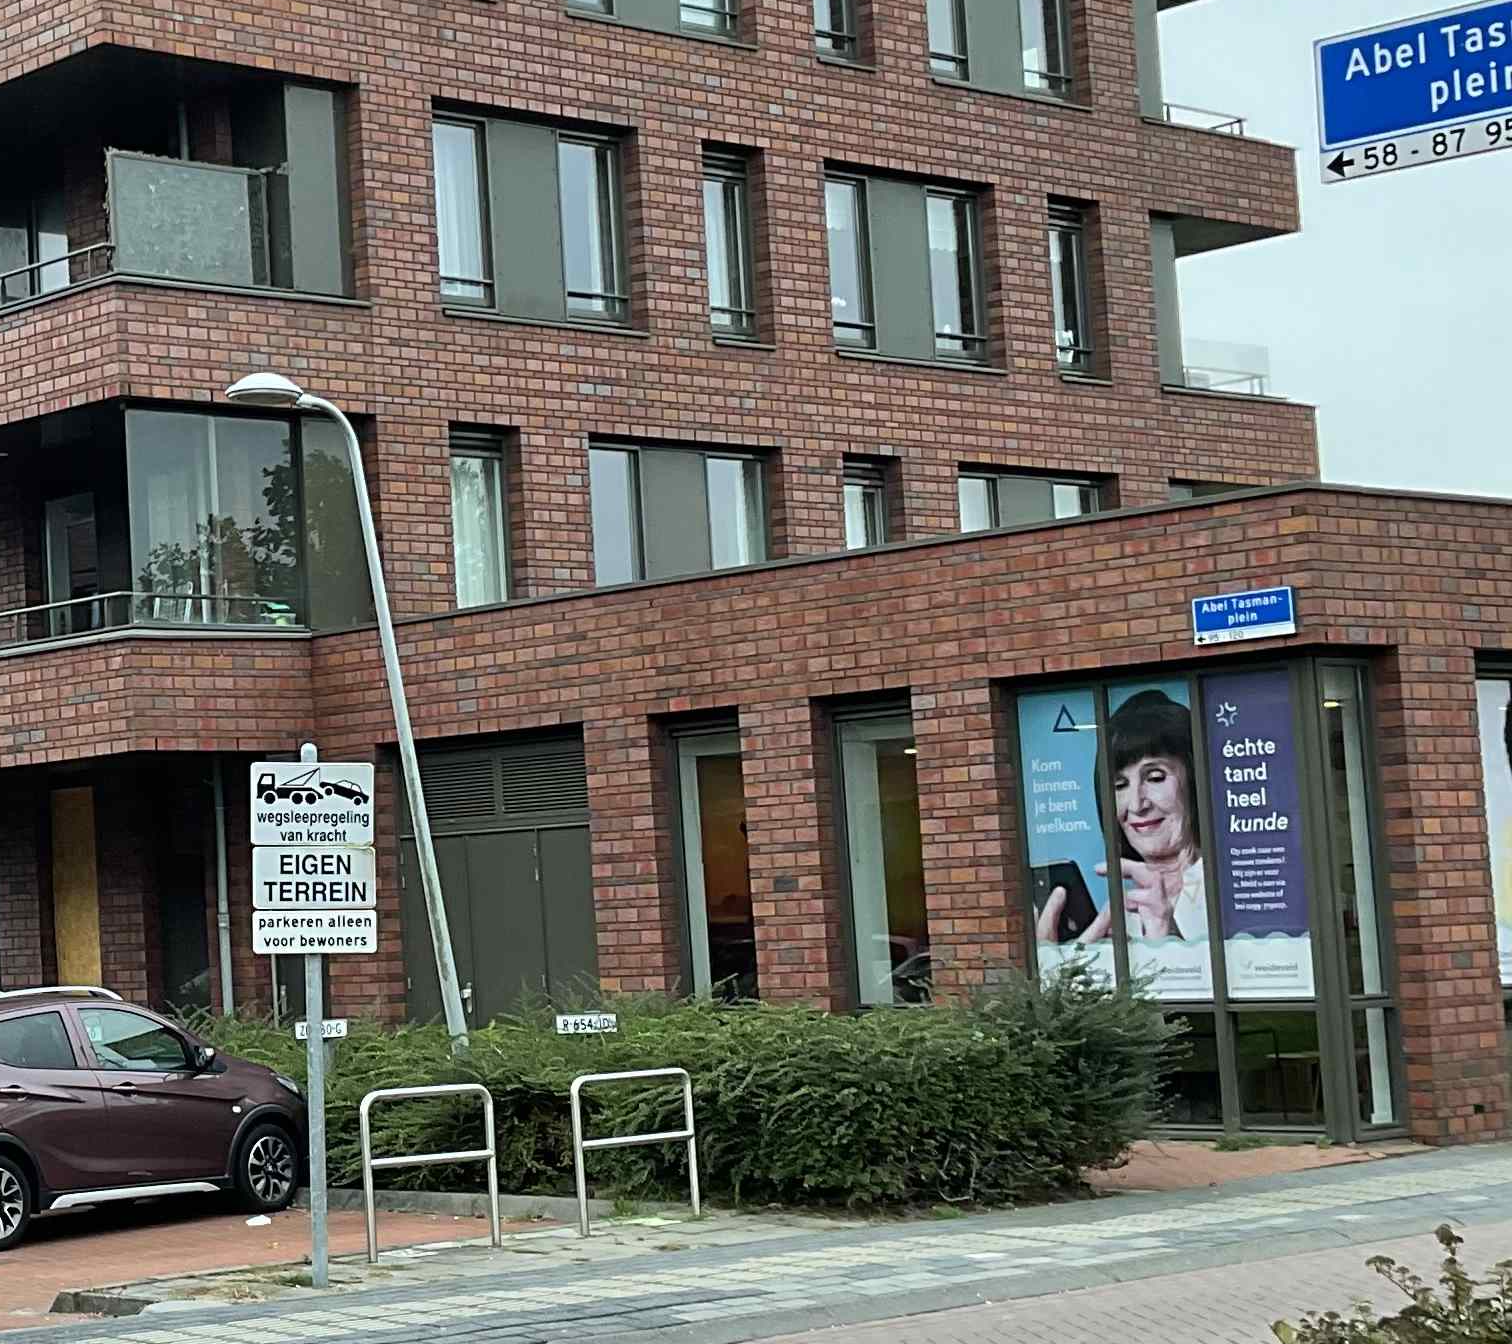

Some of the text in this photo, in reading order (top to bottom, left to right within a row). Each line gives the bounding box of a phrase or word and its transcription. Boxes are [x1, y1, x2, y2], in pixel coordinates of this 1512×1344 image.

[1345, 22, 1512, 81] Abel Tas
[1364, 143, 1398, 170] 58
[1432, 128, 1465, 155] 87
[1201, 594, 1284, 614] Abel Tasman-
[1228, 611, 1258, 626] plein
[1222, 737, 1276, 758] échte
[1031, 758, 1062, 773] Kom
[1224, 761, 1267, 783] tand
[1032, 778, 1081, 794] binnen.
[1048, 795, 1078, 813] bent
[1226, 786, 1266, 808] heel
[256, 810, 370, 828] wegsleepregeling
[1036, 817, 1092, 834] welkom.
[1229, 811, 1289, 833] kunde
[279, 828, 348, 842] van kracht
[279, 854, 351, 875] EIGEN
[263, 881, 367, 902] TERREIN
[258, 914, 372, 931] parkeren alleen
[263, 934, 368, 948] voor bewoners
